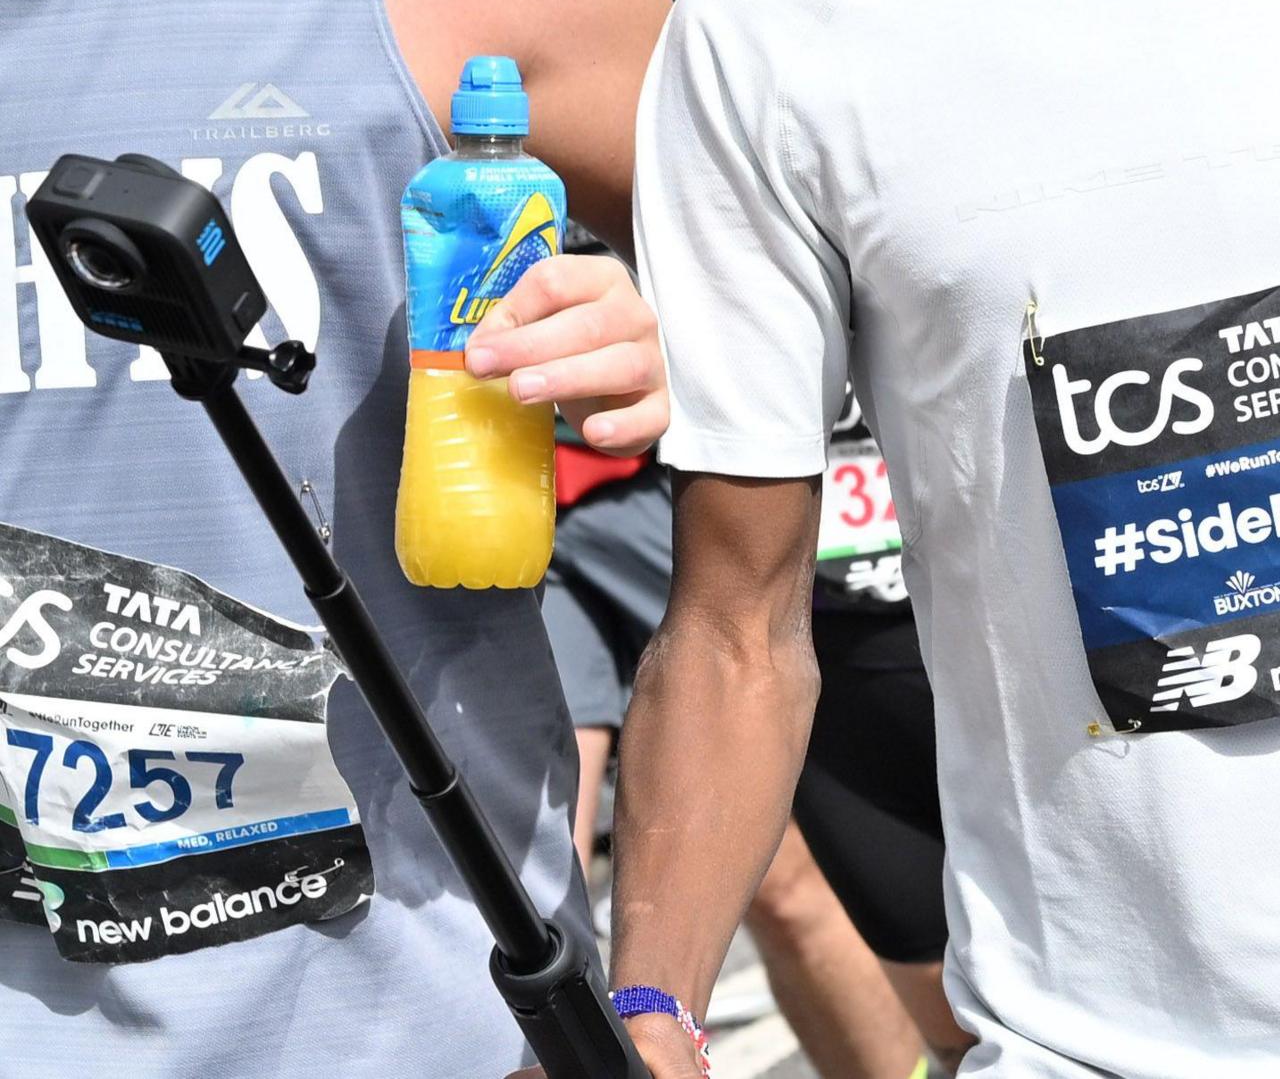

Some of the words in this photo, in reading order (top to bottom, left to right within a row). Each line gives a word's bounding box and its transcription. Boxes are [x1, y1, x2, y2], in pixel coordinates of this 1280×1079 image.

[190, 123, 333, 141] TRAILBERG
[1052, 358, 1215, 456] tcs
[103, 583, 202, 636] TATA
[71, 653, 224, 688] SERVICES
[88, 621, 326, 671] CONSULTANCY
[5, 728, 246, 834] 7257
[215, 820, 279, 844] RELAXED
[76, 914, 152, 946] new
[161, 871, 328, 936] balance
